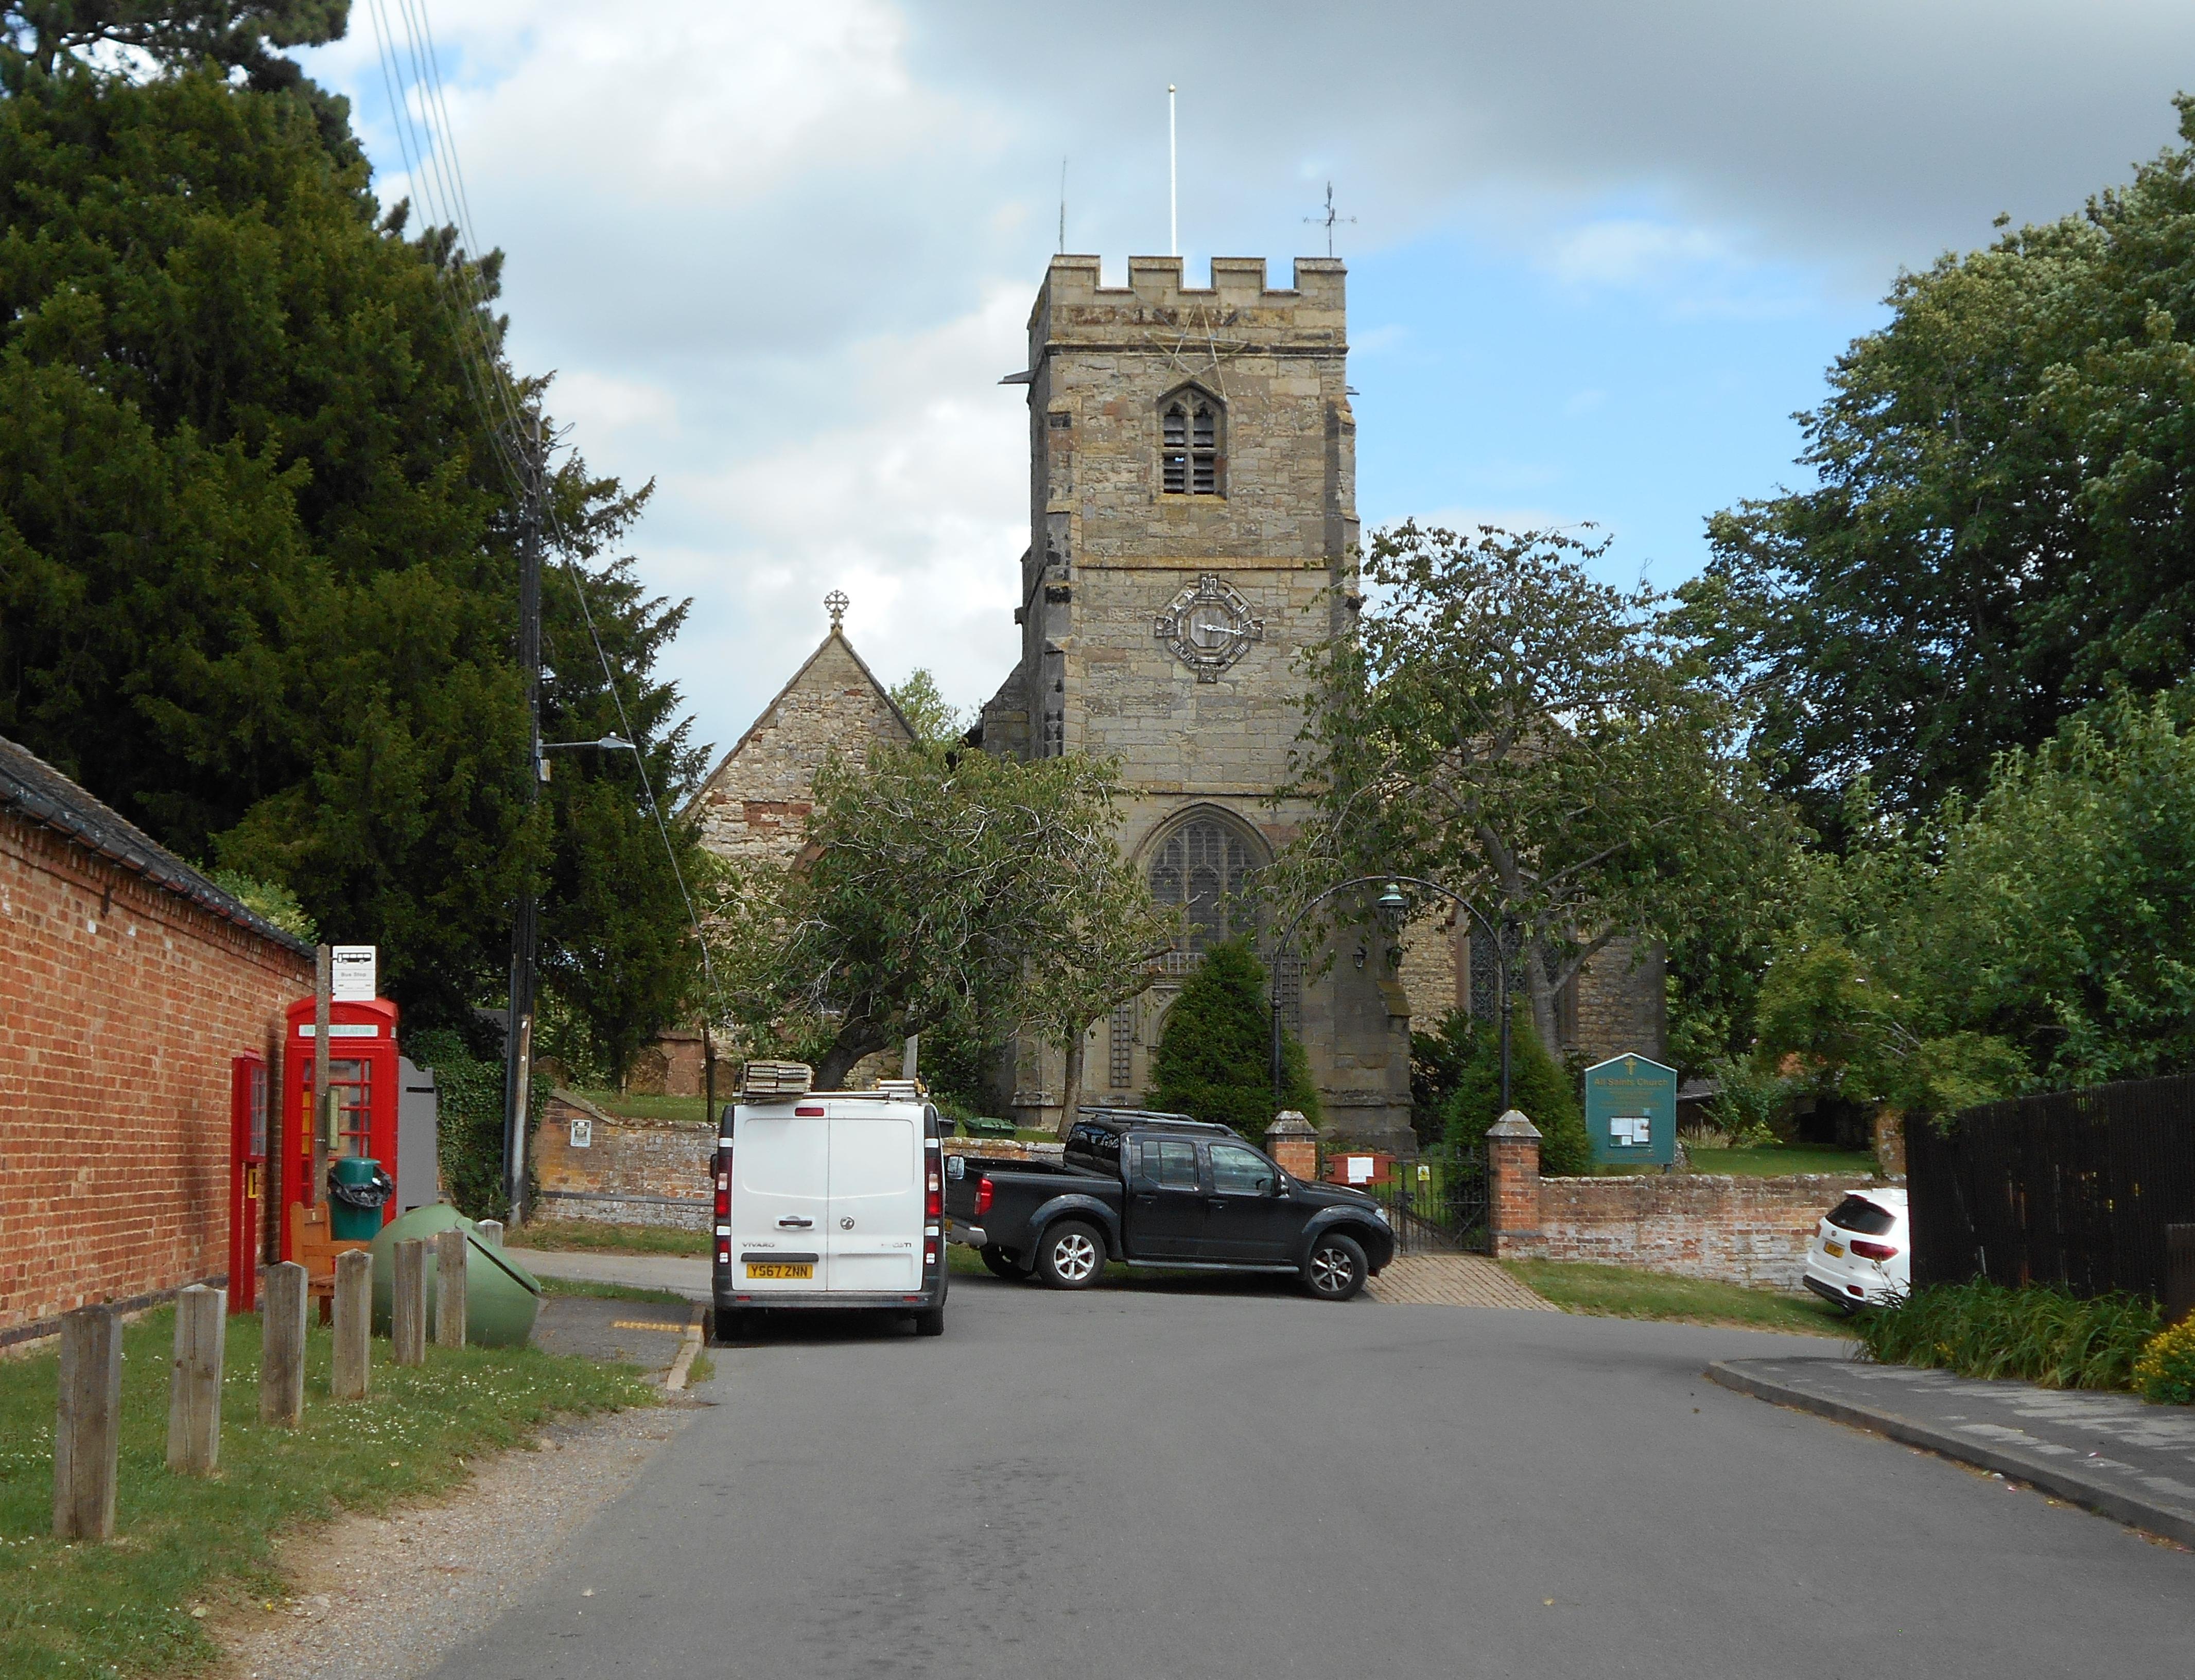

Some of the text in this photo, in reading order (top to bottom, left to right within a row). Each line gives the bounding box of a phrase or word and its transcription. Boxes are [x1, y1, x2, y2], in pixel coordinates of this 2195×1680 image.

[304, 1026, 372, 1034] DERILLATOR
[1637, 1078, 1668, 1087] Church
[752, 1266, 808, 1278] YS67 ZNN
